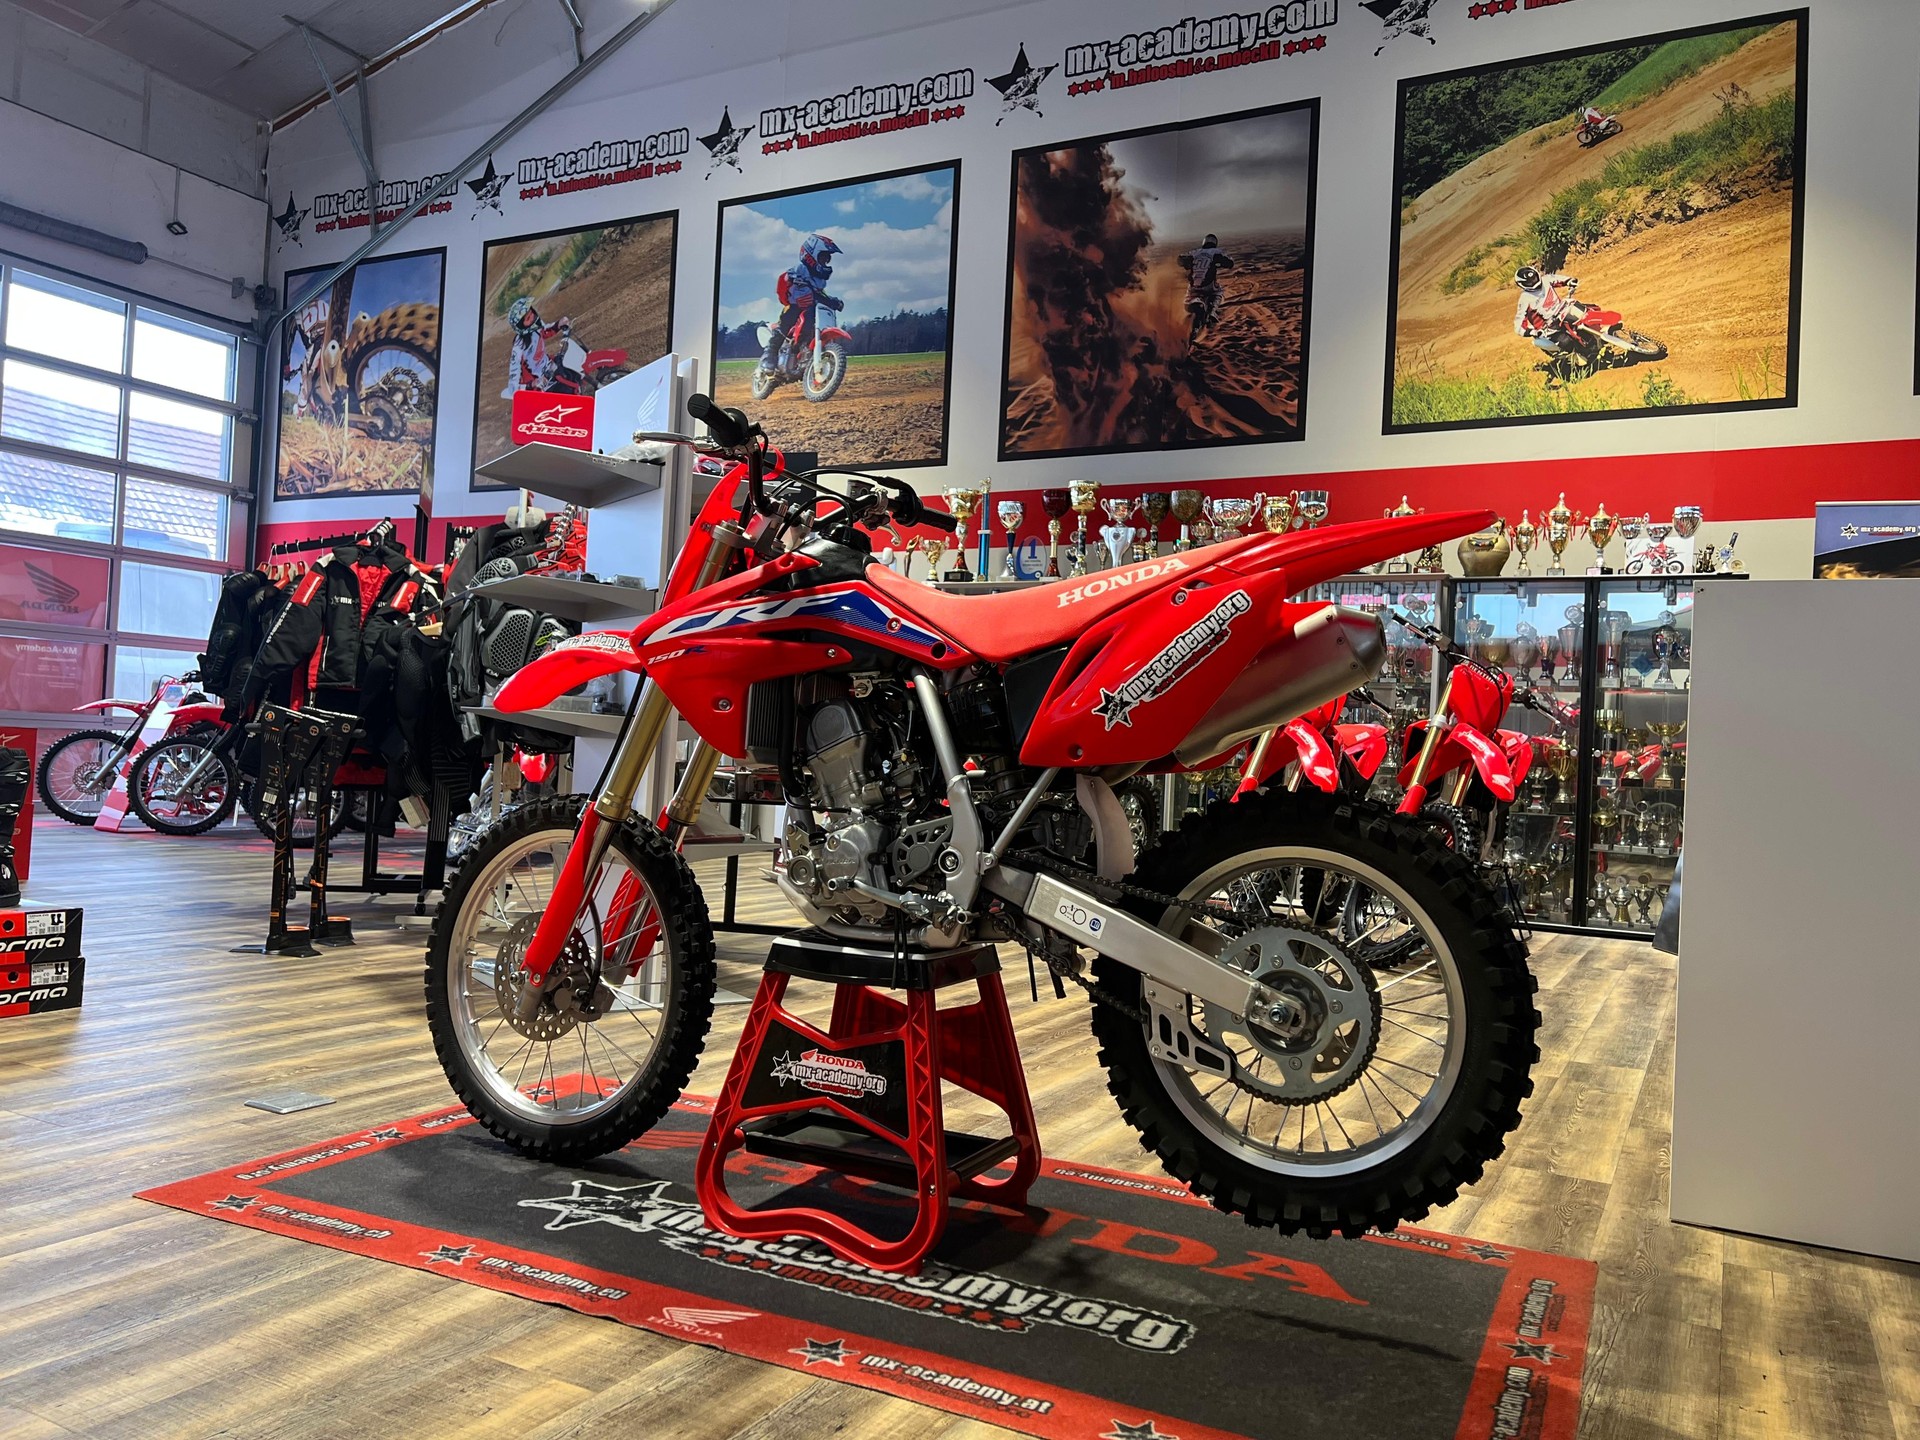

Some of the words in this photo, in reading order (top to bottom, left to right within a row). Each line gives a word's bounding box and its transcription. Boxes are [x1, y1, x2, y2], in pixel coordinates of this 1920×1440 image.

[1065, 0, 1339, 77] mx-academy.com
[760, 68, 974, 138] mx-academy.com
[518, 127, 690, 184] mx-academy.com
[1028, 538, 1038, 559] 1
[1057, 558, 1190, 609] HONDA
[1124, 591, 1250, 701] mx-academy.org
[794, 1063, 886, 1095] mx-academy.org
[815, 1053, 865, 1070] HONDA
[1053, 1167, 1189, 1198] mx-academy.eu
[260, 1204, 394, 1240] mx-academy.ch
[480, 1256, 630, 1301] mx-academy.eu
[646, 1315, 725, 1342] HONDA
[859, 1353, 1055, 1415] mx-academy.at
